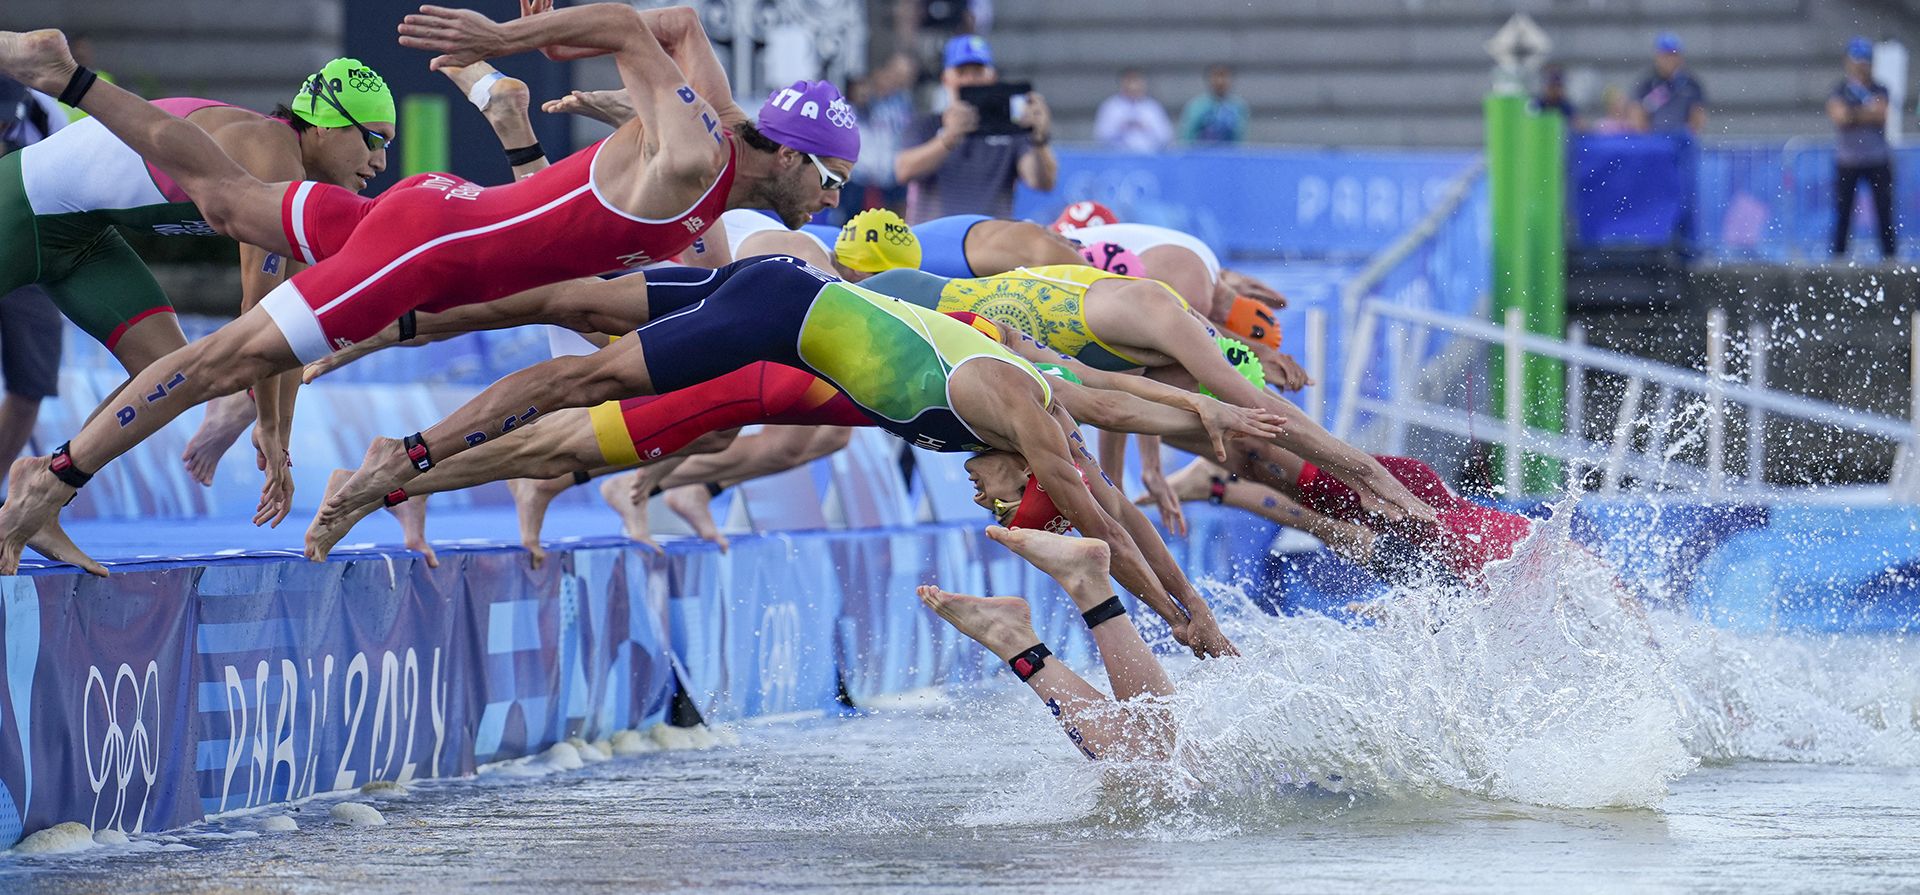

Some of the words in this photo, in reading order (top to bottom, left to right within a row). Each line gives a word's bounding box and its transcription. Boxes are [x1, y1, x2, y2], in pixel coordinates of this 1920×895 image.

[772, 88, 803, 112] 17
[800, 101, 819, 120] A
[865, 229, 878, 243] A
[262, 251, 281, 276] A
[115, 404, 136, 428] A
